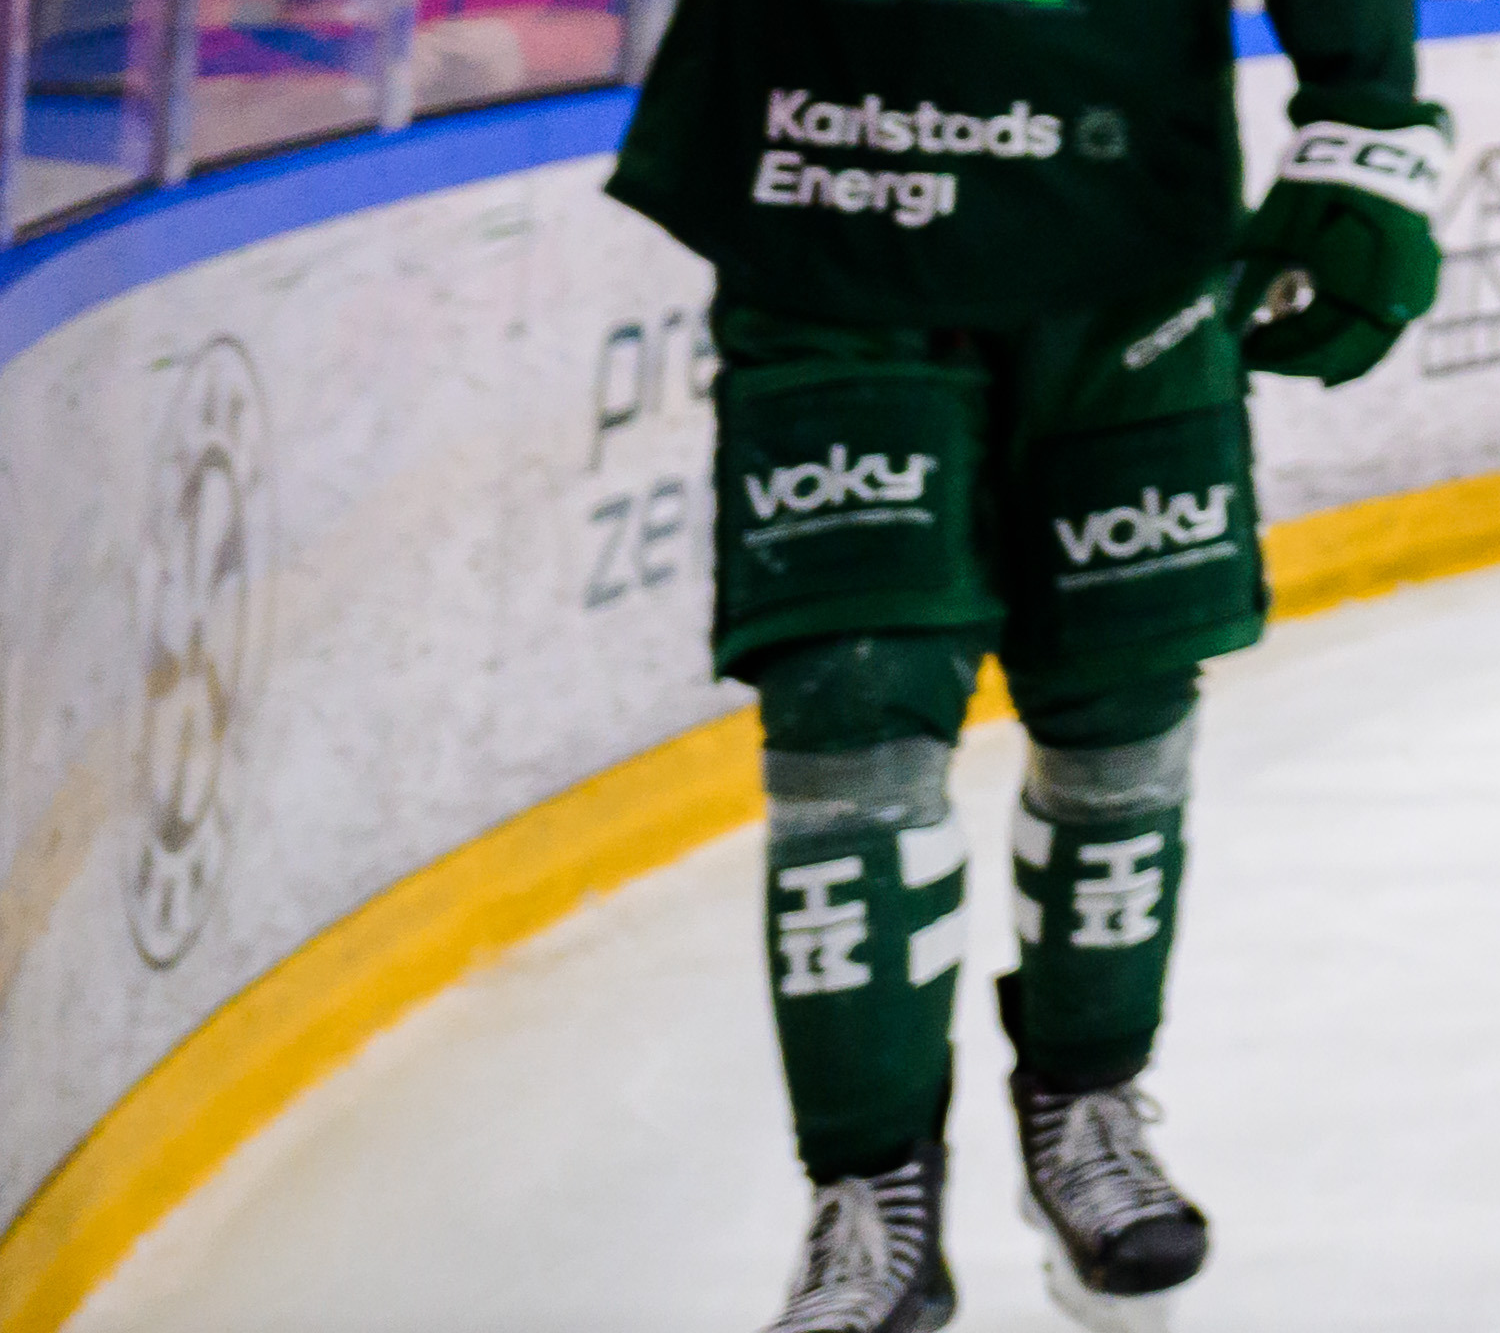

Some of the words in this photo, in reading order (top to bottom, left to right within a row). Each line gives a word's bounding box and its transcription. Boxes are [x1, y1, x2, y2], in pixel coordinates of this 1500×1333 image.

[765, 88, 1063, 160] Karlstads
[752, 150, 957, 229] Energi
[743, 442, 938, 521] voky
[584, 478, 688, 611] ze
[1053, 483, 1237, 566] voky
